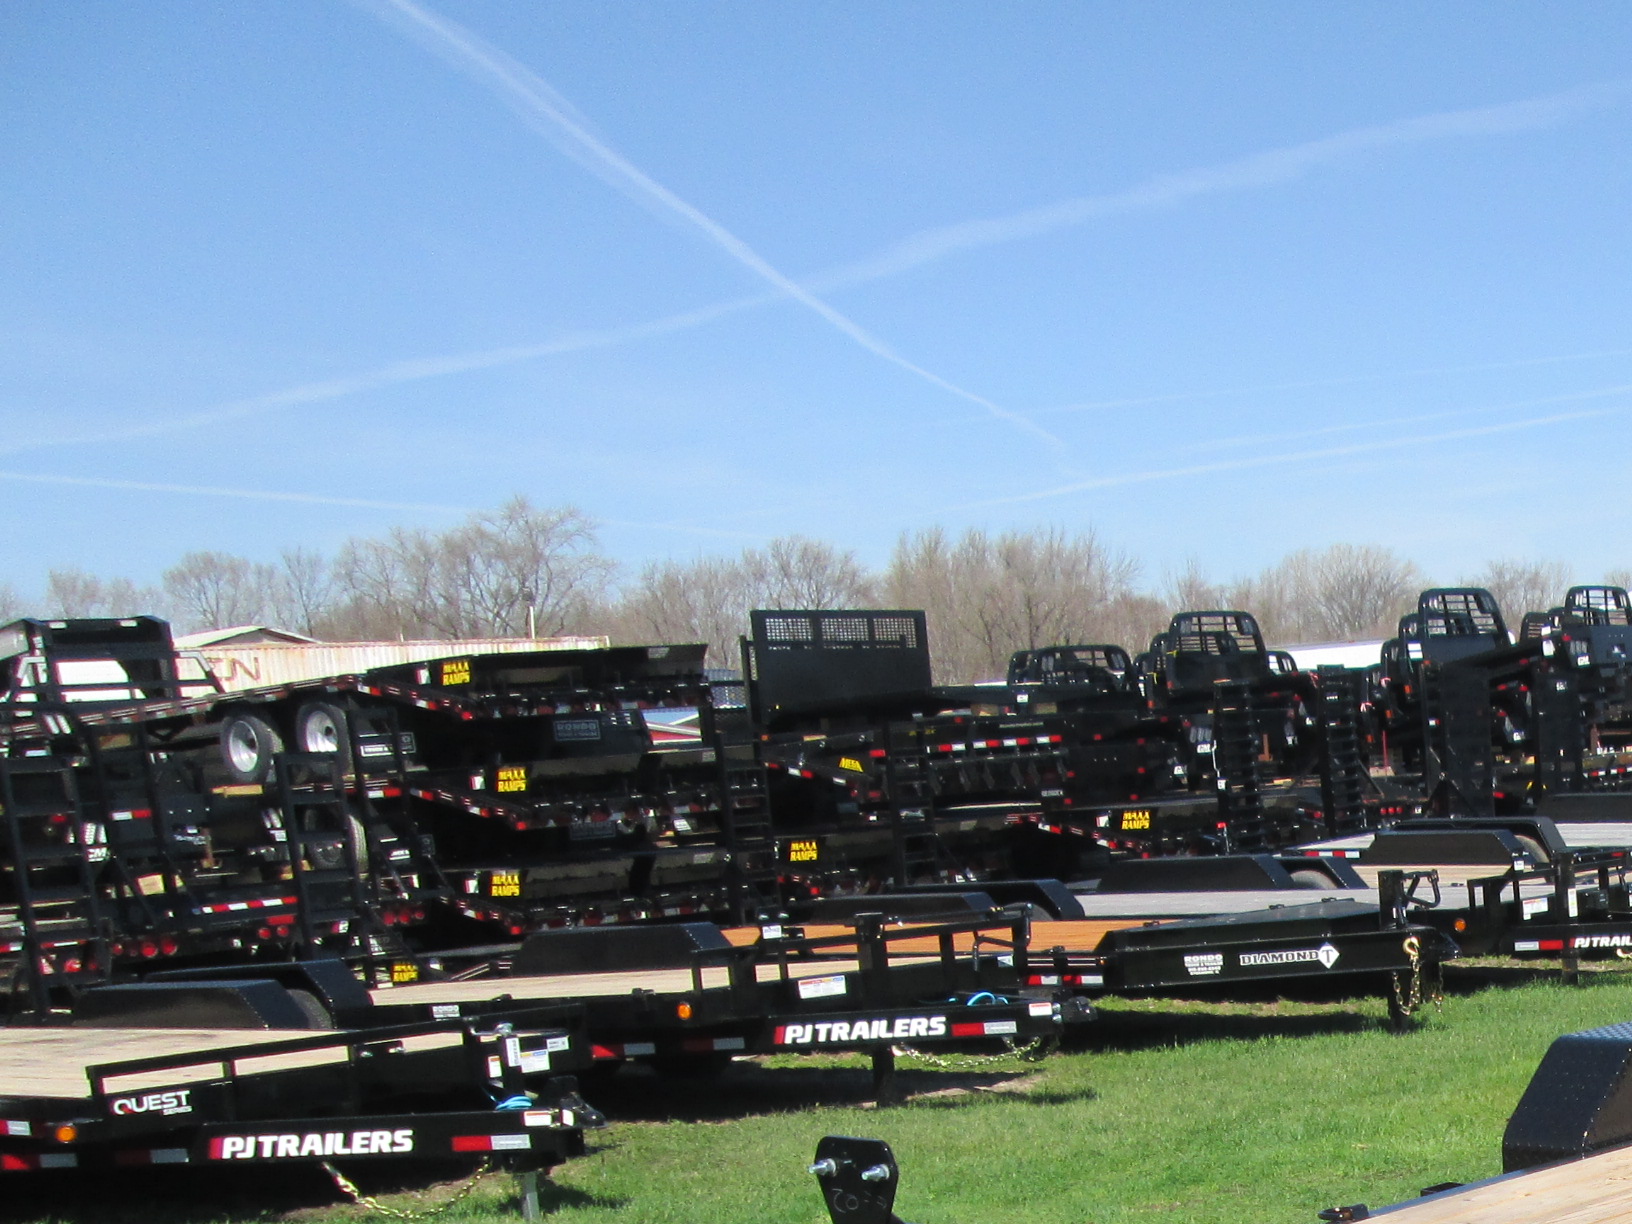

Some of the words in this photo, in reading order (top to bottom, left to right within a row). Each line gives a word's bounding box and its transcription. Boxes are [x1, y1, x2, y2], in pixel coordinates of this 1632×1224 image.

[442, 672, 471, 686] RAMPS
[497, 779, 527, 792] RAMPS
[1122, 811, 1150, 821] MAXX
[1121, 820, 1150, 830] RAMPS
[790, 850, 818, 862] RAMPS
[491, 884, 521, 897] RAMPS
[1574, 936, 1591, 949] PJ
[1184, 954, 1223, 963] RONDO
[1240, 949, 1319, 966] DIAMOND
[784, 1024, 814, 1044] PJ
[815, 1016, 947, 1042] TRAILERS
[113, 1090, 191, 1115] QUEST
[221, 1136, 256, 1160] PJ
[257, 1130, 414, 1158] TRAILERS
